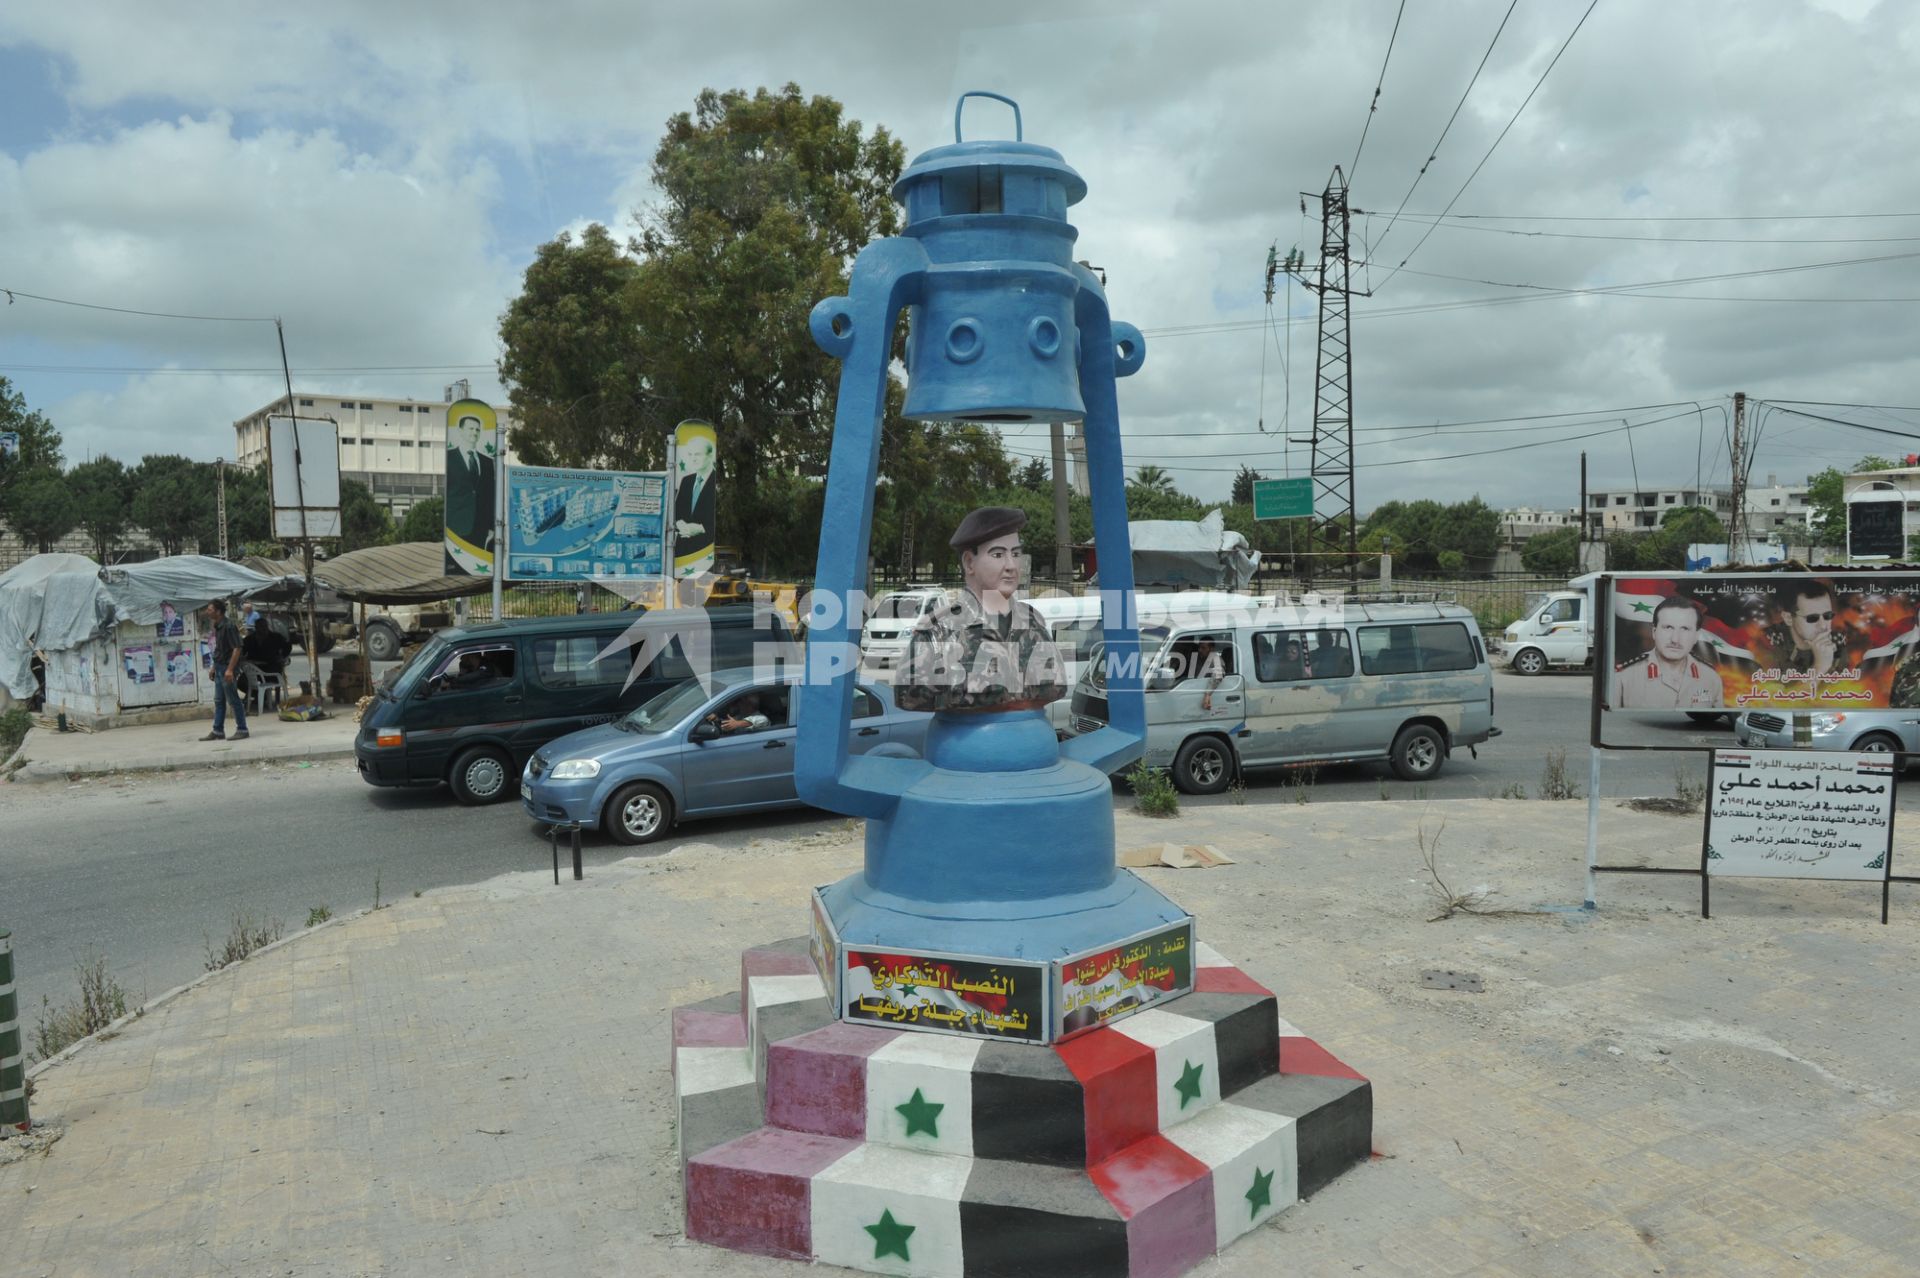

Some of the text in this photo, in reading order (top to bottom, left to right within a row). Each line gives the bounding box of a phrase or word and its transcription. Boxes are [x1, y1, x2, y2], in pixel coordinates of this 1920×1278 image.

[1693, 584, 1714, 597] عليه
[1717, 579, 1733, 594] الله
[1735, 584, 1767, 597] عاهدوا
[1766, 584, 1777, 594] ما
[1834, 583, 1864, 596] صدقوا
[1866, 583, 1887, 596] رجال
[1752, 668, 1860, 683] الشهيد البطل اللواء
[1736, 681, 1873, 707] محمد أحمد علي
[1754, 759, 1854, 772] ساحة الشهيد اللواء
[1719, 772, 1885, 795] محمد أحمد علي
[1746, 798, 1762, 807] عام
[1798, 801, 1821, 811] قرية
[1822, 801, 1832, 812] في
[1834, 803, 1863, 813] الشهيد
[1729, 810, 1754, 818] منطقة
[1865, 804, 1881, 815] ولد
[1764, 812, 1788, 821] الوطن
[1820, 815, 1846, 824] الشهادة
[1847, 816, 1867, 826] شرف
[1868, 817, 1887, 828] ونال
[1811, 828, 1838, 838] بتاريخ
[1731, 835, 1755, 844] الوطن
[1755, 836, 1773, 845] تراب
[1774, 837, 1800, 846] الطاهر
[1849, 840, 1862, 850] بعد
[922, 998, 968, 1027] جبلة
[970, 1008, 1029, 1032] لشهداء
